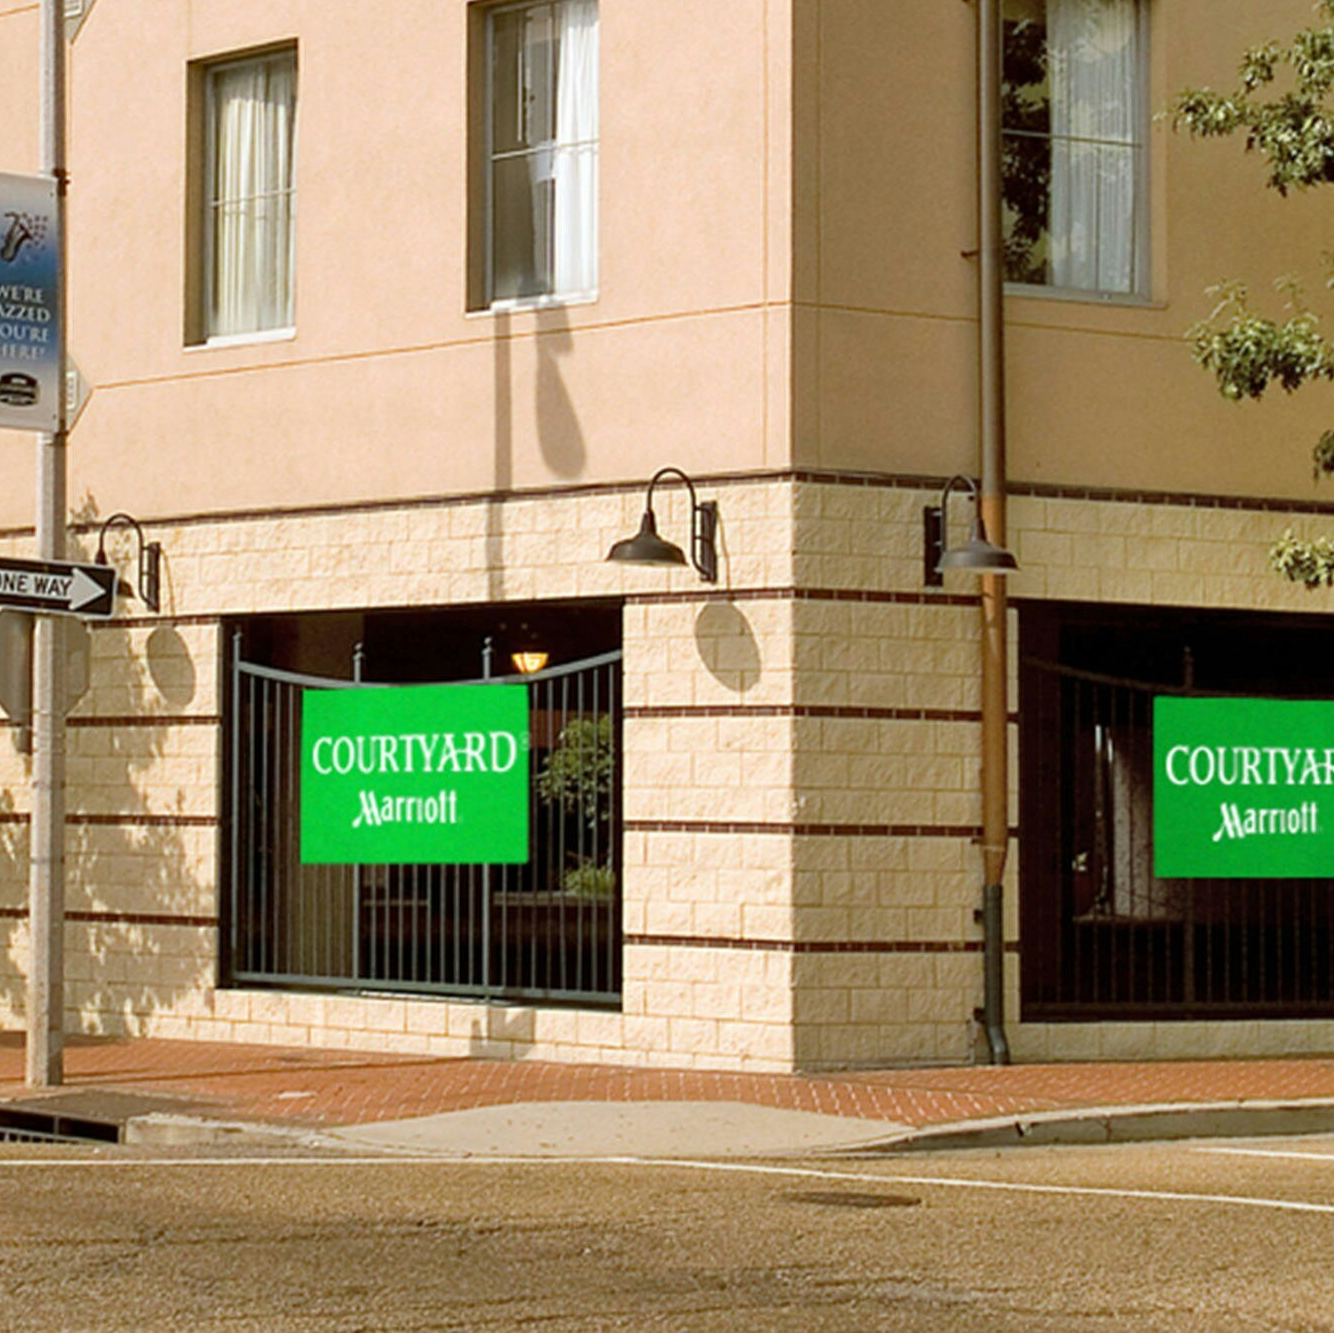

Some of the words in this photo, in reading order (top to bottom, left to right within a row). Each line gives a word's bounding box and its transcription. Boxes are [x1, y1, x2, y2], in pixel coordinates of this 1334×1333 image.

[34, 575, 72, 597] WAY
[312, 731, 517, 774] COURTYARD
[352, 790, 457, 828] Marriott
[1212, 802, 1318, 842] Marriott
